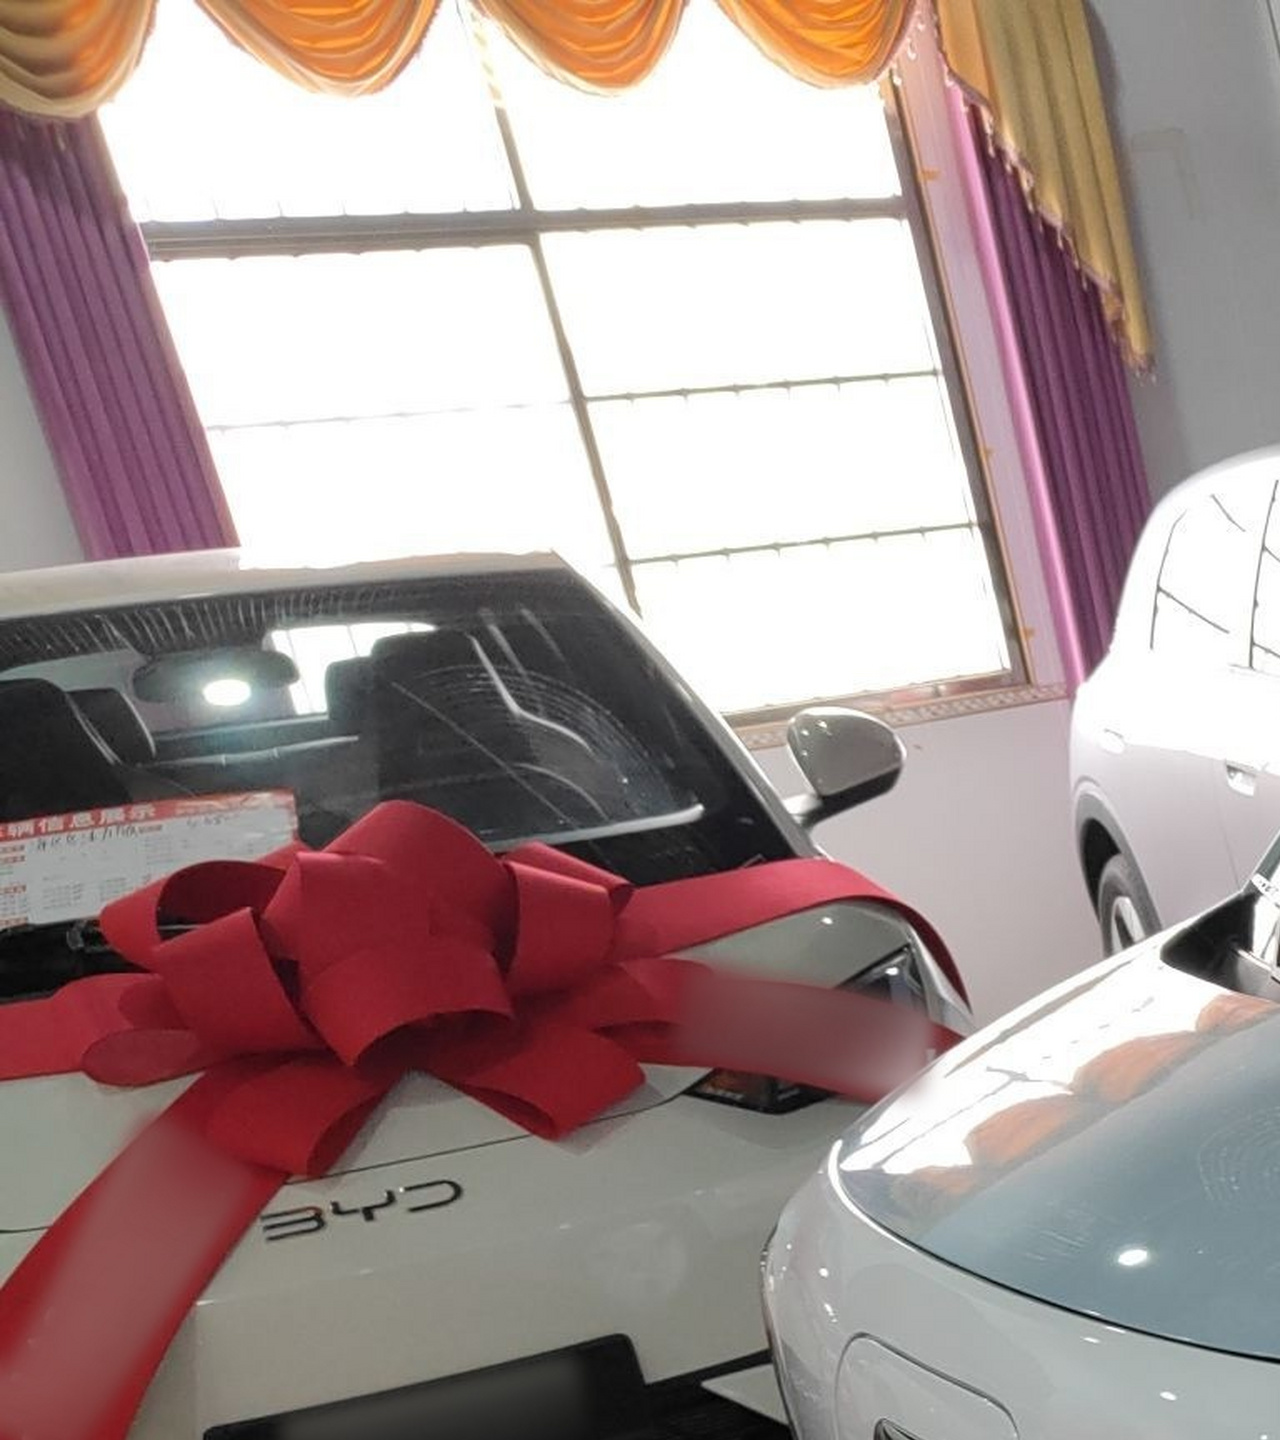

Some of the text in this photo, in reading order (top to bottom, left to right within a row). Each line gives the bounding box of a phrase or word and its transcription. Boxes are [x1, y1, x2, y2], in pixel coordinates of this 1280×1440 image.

[0, 803, 156, 838] 辆信息展示
[260, 1179, 463, 1241] BYD
